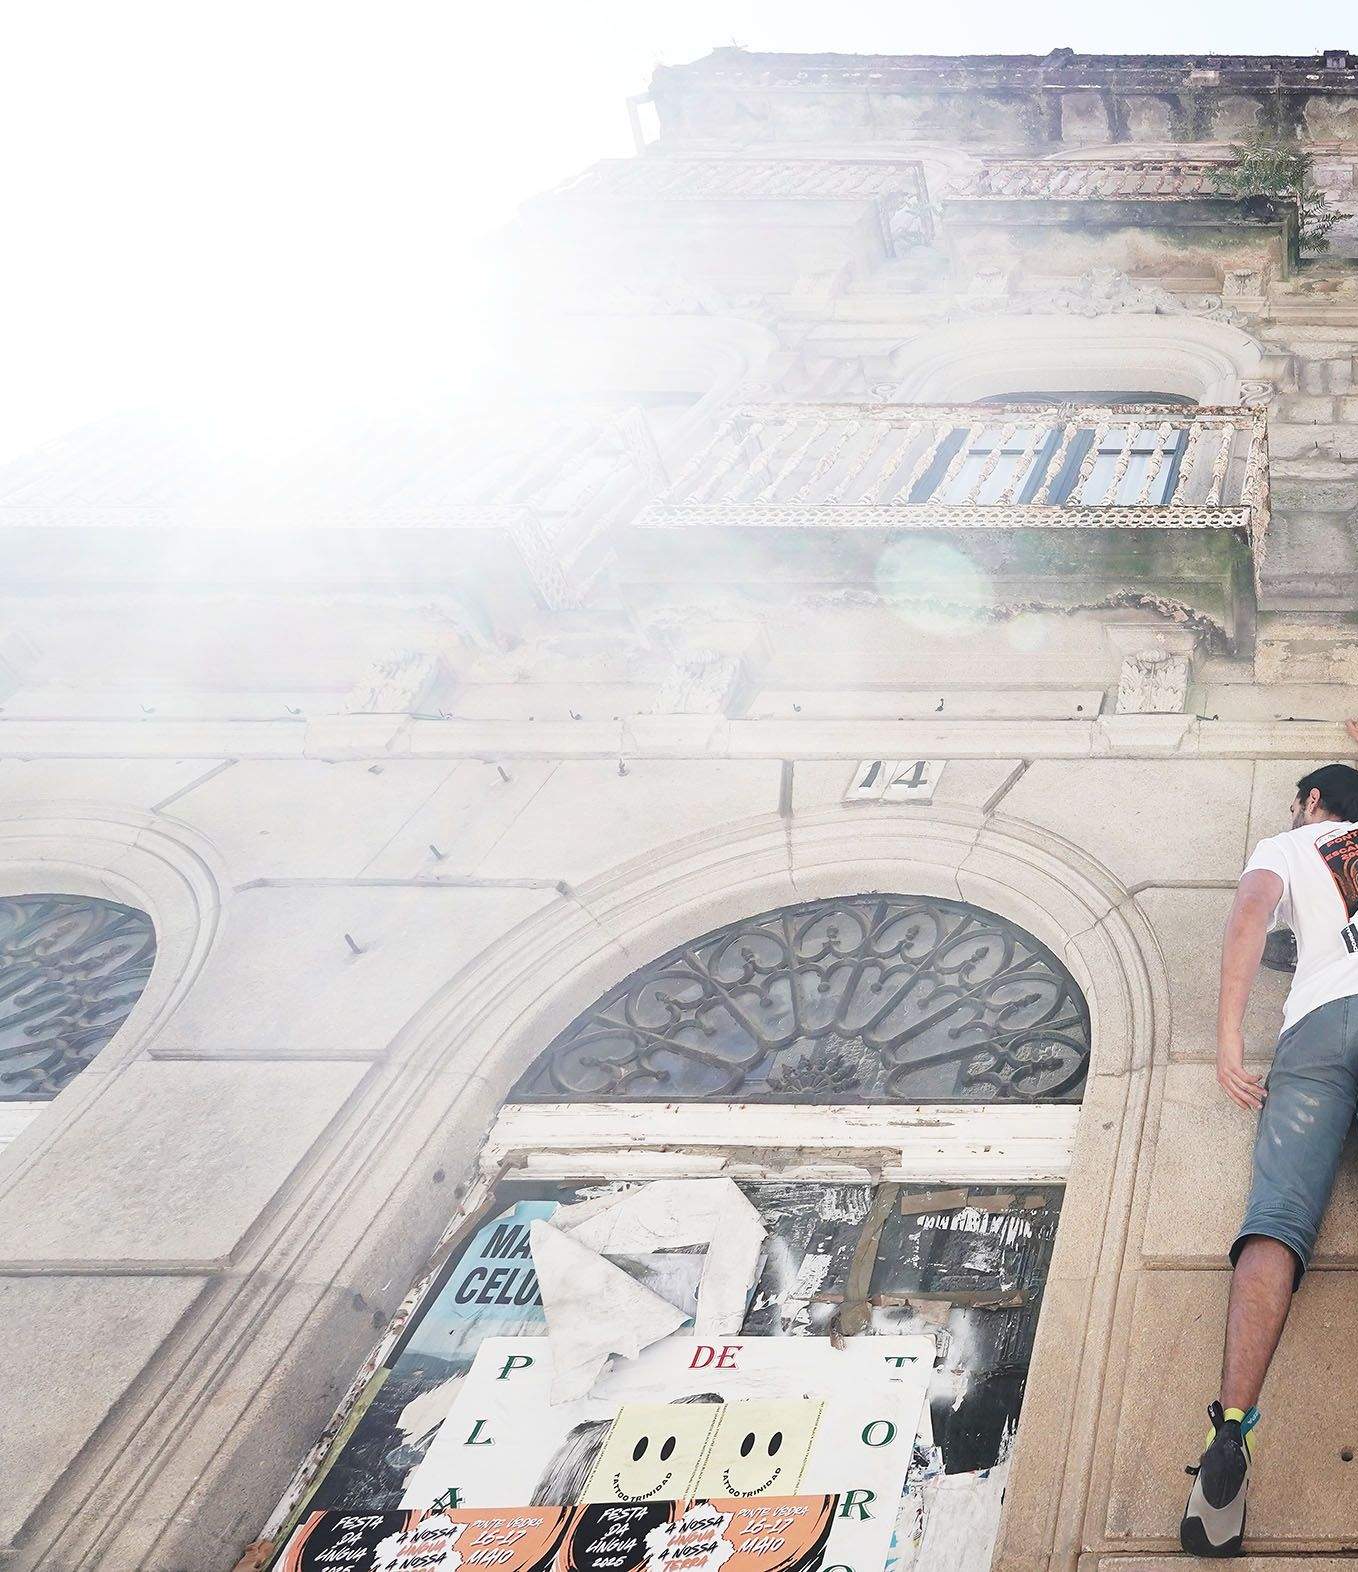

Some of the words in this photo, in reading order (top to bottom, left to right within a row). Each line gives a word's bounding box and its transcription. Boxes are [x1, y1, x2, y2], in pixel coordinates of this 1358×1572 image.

[858, 760, 928, 788] 14
[454, 1267, 544, 1306] CELU
[688, 1345, 743, 1369] DE
[613, 1472, 630, 1502] TATTOO
[630, 1472, 673, 1503] TRINIDAD
[722, 1468, 740, 1497] TATTOO
[742, 1467, 781, 1498] TRINIDAD
[331, 1515, 384, 1532] FESTA
[597, 1506, 649, 1524] FESTA
[395, 1532, 409, 1543] A
[410, 1526, 458, 1543] NOSSA
[604, 1523, 630, 1538] DA
[664, 1522, 677, 1535] A
[678, 1516, 724, 1533] NOSSA
[739, 1518, 795, 1536] 16-17
[335, 1531, 363, 1547] DA
[737, 1535, 786, 1557] MAIO
[657, 1548, 671, 1560] A
[671, 1541, 719, 1559] NOSSA
[384, 1558, 399, 1570] A
[400, 1551, 448, 1569] NOSSA
[591, 1555, 628, 1568] 2025
